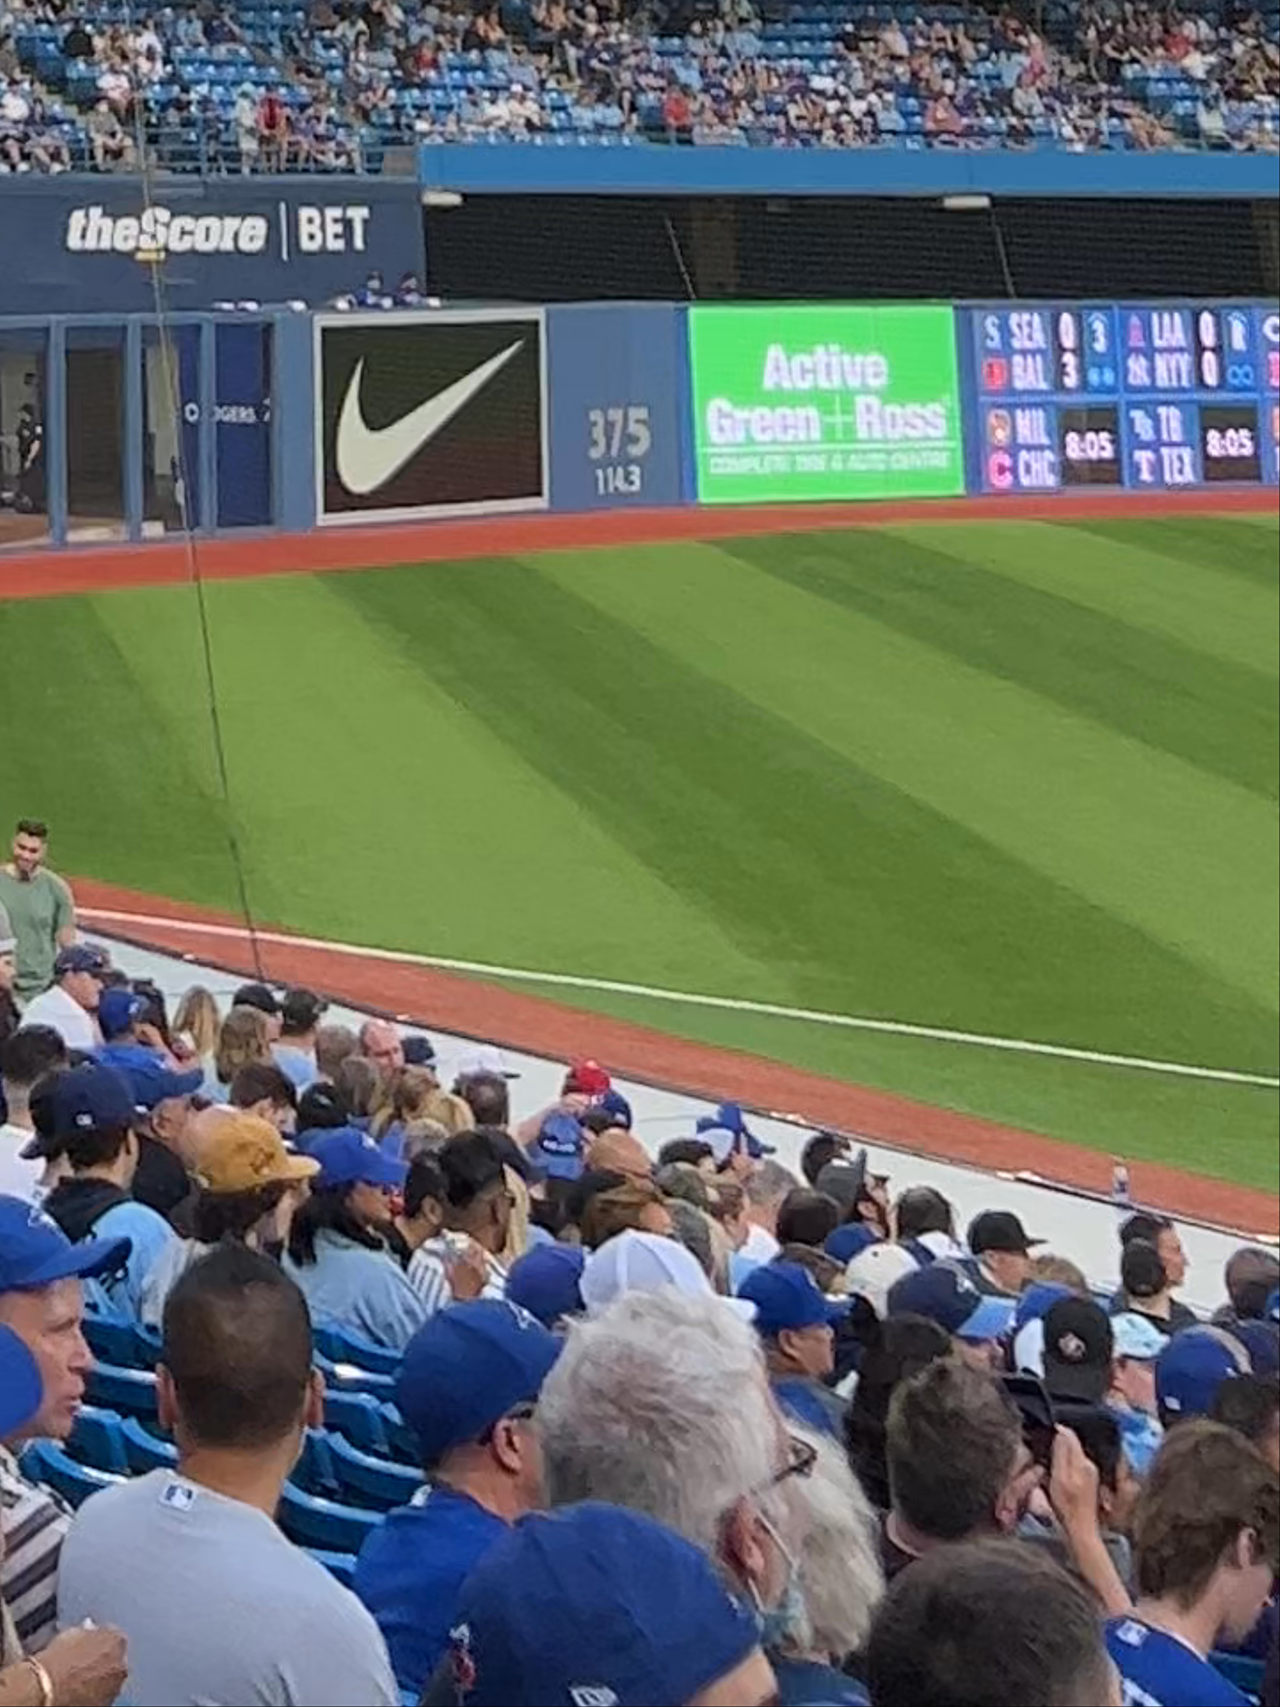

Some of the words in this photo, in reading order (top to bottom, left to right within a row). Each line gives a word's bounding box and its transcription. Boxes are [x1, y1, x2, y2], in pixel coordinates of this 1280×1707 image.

[67, 205, 266, 254] theScore
[298, 205, 370, 252] BET
[1008, 312, 1047, 349] SEA
[1059, 312, 1075, 349] 0
[1151, 312, 1187, 348] LAA
[1199, 311, 1217, 348] 0
[762, 344, 889, 392] Active
[1012, 353, 1050, 390] BAL
[1061, 352, 1078, 388] 3
[1154, 352, 1191, 388] NYY
[1201, 350, 1218, 387] 0
[588, 407, 651, 459] 375
[1065, 431, 1115, 460] 8:05
[1206, 429, 1255, 457] 8:05
[1018, 449, 1057, 486] CHC
[1160, 446, 1195, 485] TEX
